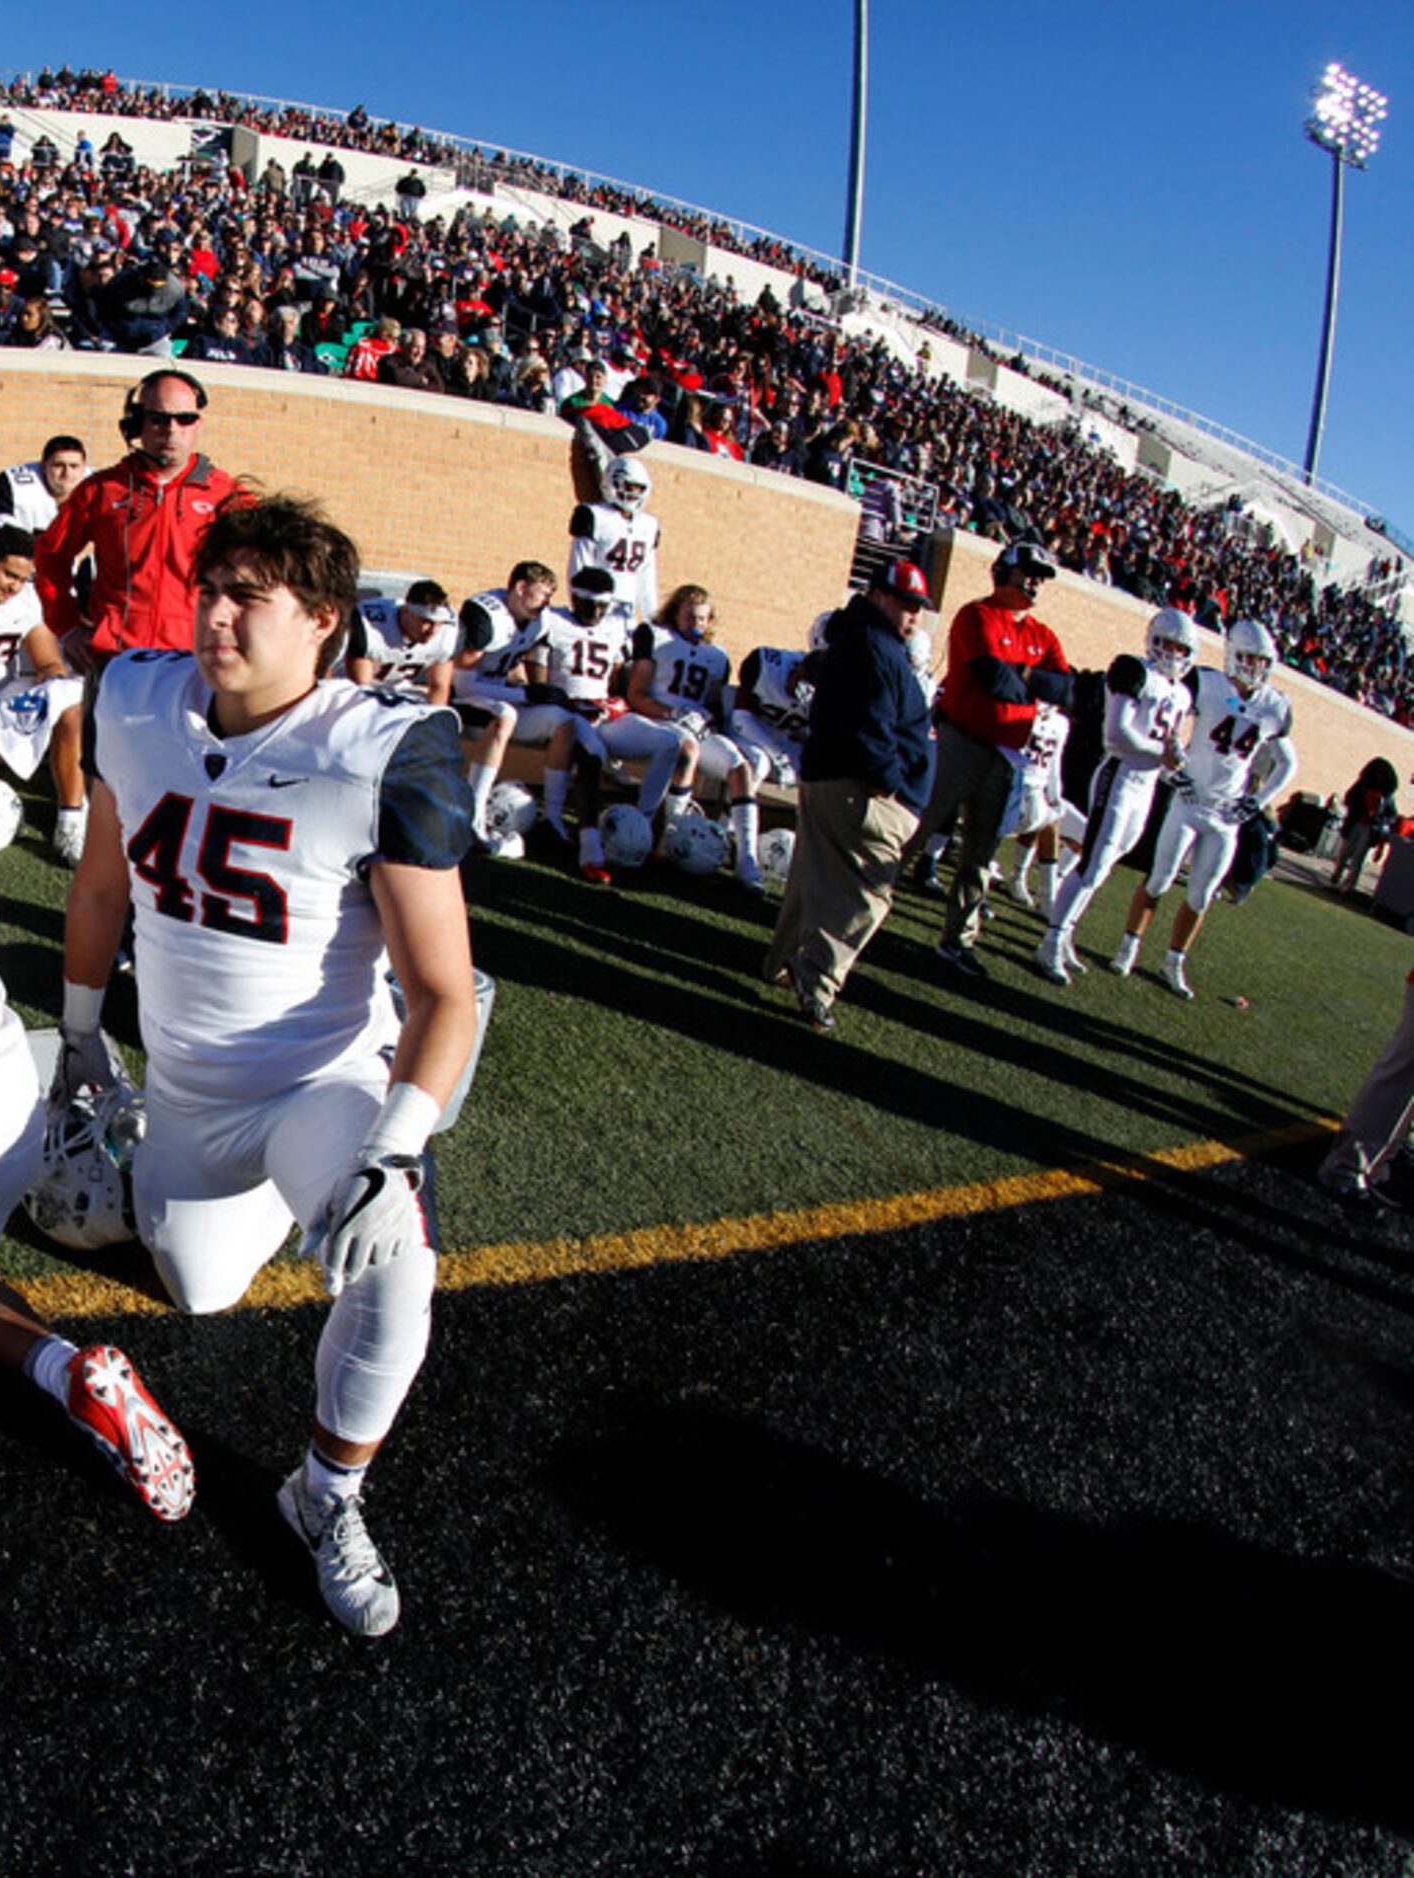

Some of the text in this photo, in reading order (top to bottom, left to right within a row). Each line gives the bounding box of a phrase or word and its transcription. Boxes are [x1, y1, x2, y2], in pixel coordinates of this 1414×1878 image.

[604, 537, 647, 573] 48
[570, 639, 610, 681] 15
[667, 658, 709, 701] 19
[1210, 714, 1261, 761] 44
[126, 790, 293, 946] 45
